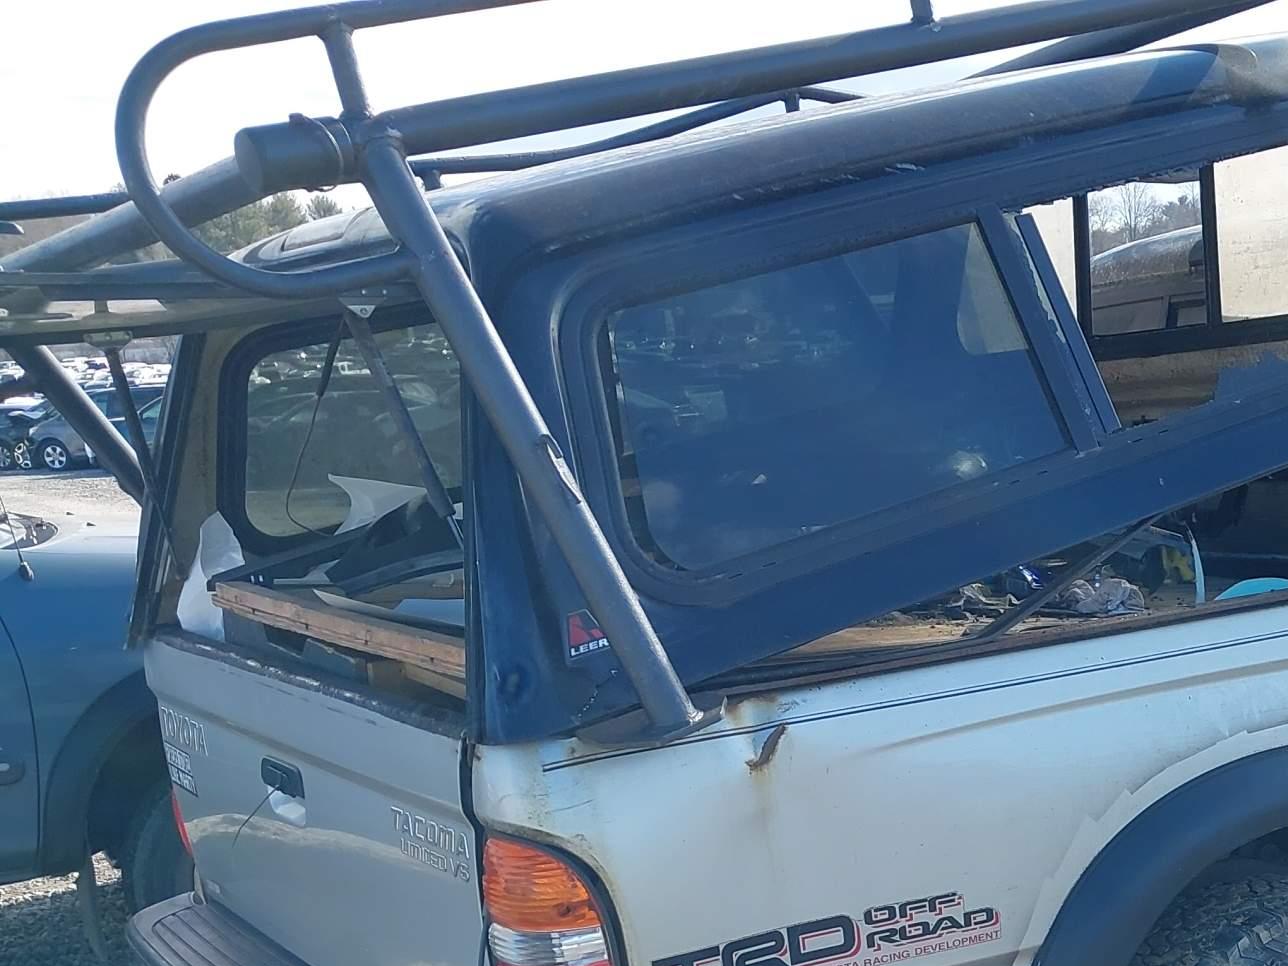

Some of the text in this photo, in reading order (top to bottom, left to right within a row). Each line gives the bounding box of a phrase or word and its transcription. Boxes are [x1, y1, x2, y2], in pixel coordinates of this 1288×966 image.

[570, 638, 609, 656] LEER
[160, 705, 209, 758] TOYOTA
[391, 805, 470, 860] TACOMA
[400, 838, 448, 873] LIMITED
[864, 891, 964, 928] OFF
[866, 907, 1000, 951] ROAD
[914, 930, 1001, 957] DEVELOPMENT
